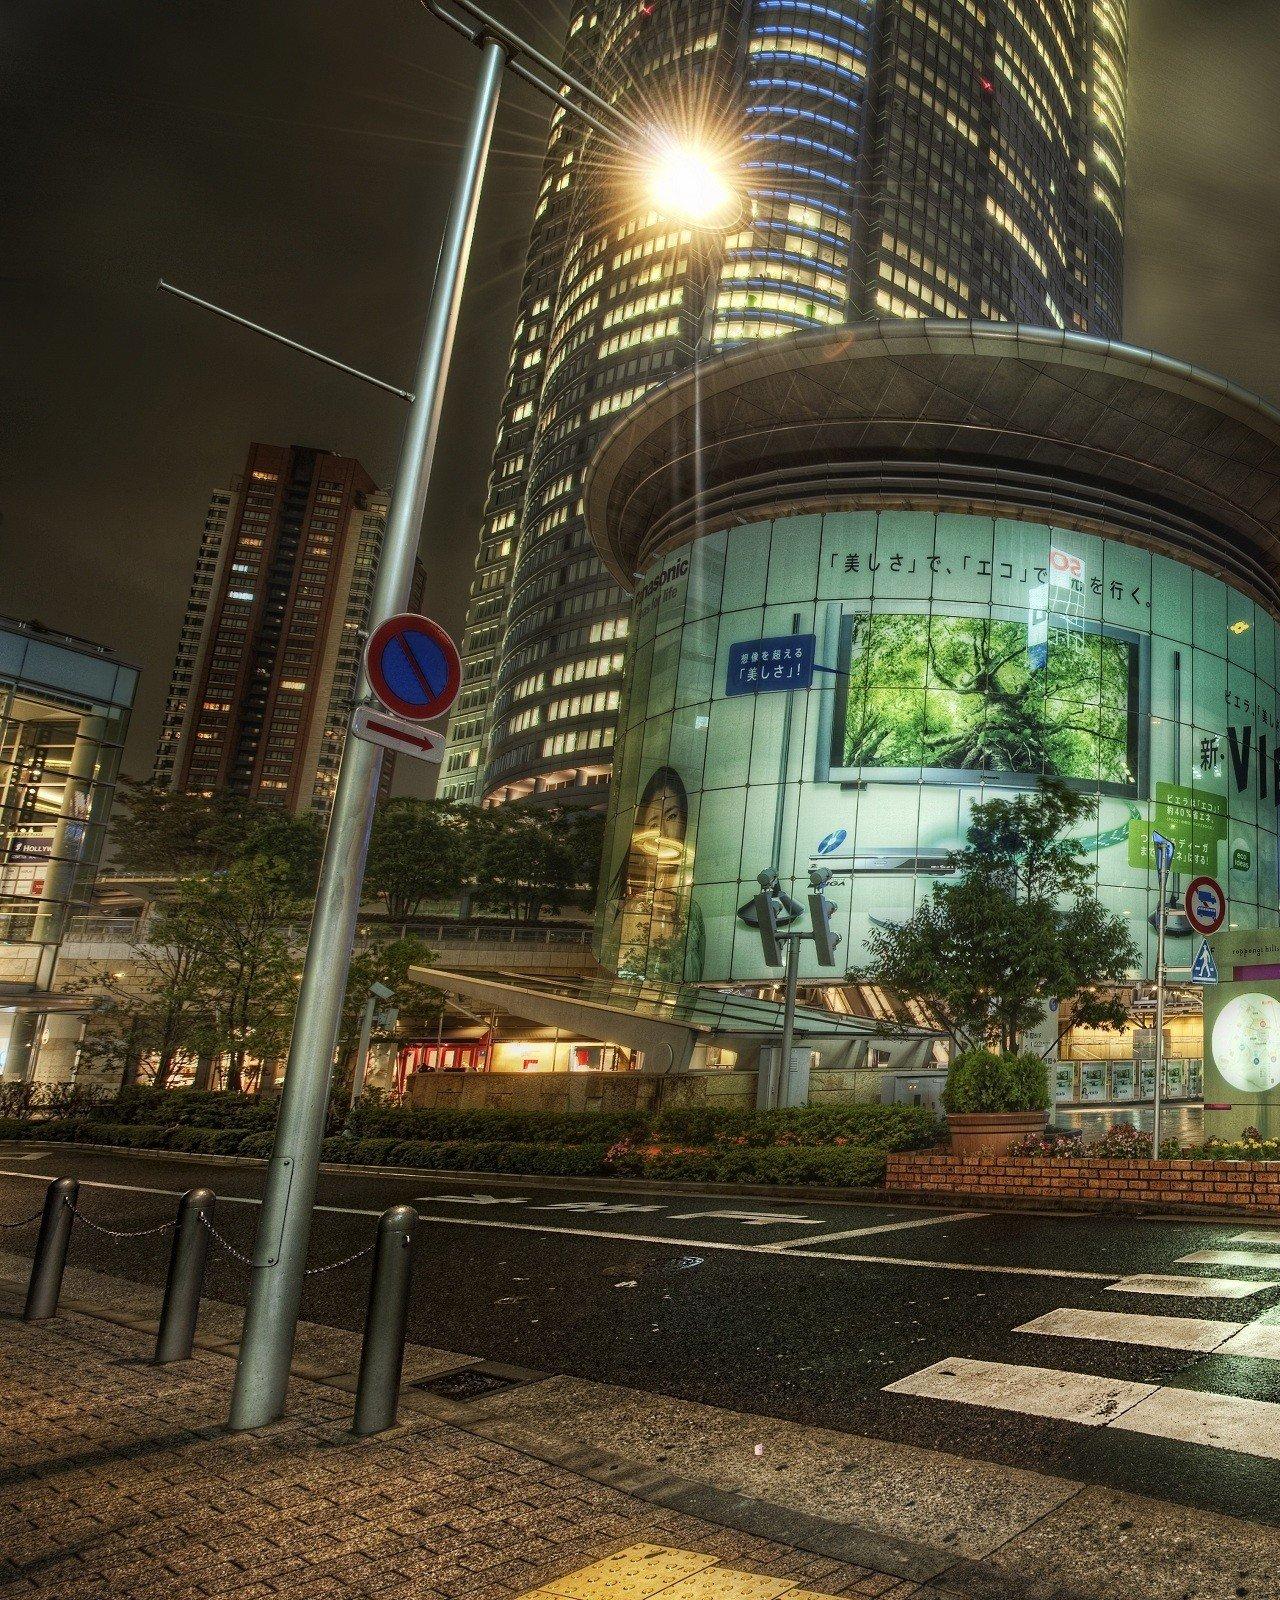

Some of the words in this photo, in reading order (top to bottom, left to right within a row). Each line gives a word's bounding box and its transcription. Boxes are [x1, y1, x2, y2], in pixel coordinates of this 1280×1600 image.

[740, 647, 803, 665] 想像を超える
